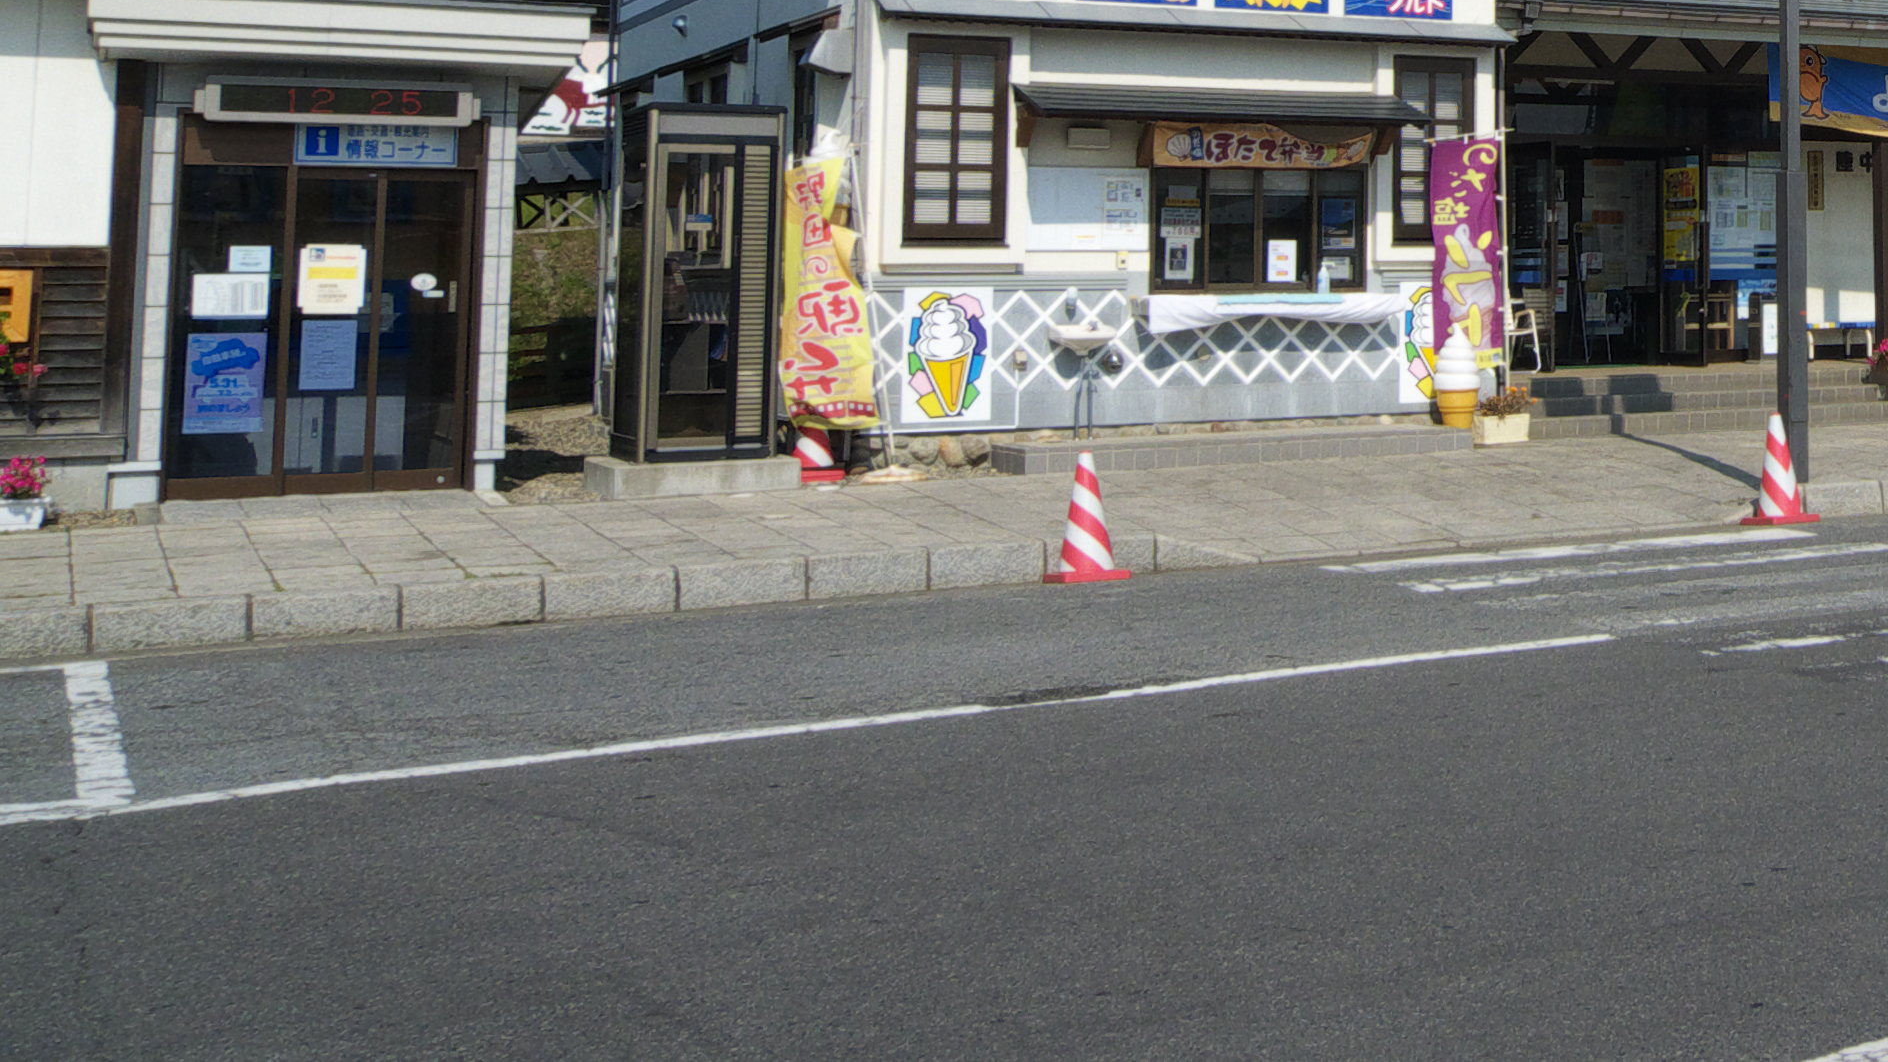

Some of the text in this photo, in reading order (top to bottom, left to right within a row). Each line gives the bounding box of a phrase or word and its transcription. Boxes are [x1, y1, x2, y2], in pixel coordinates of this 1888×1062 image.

[287, 89, 422, 116] 12 25
[346, 139, 447, 160] 情報コーナー
[1205, 131, 1326, 165] ほたて弁当
